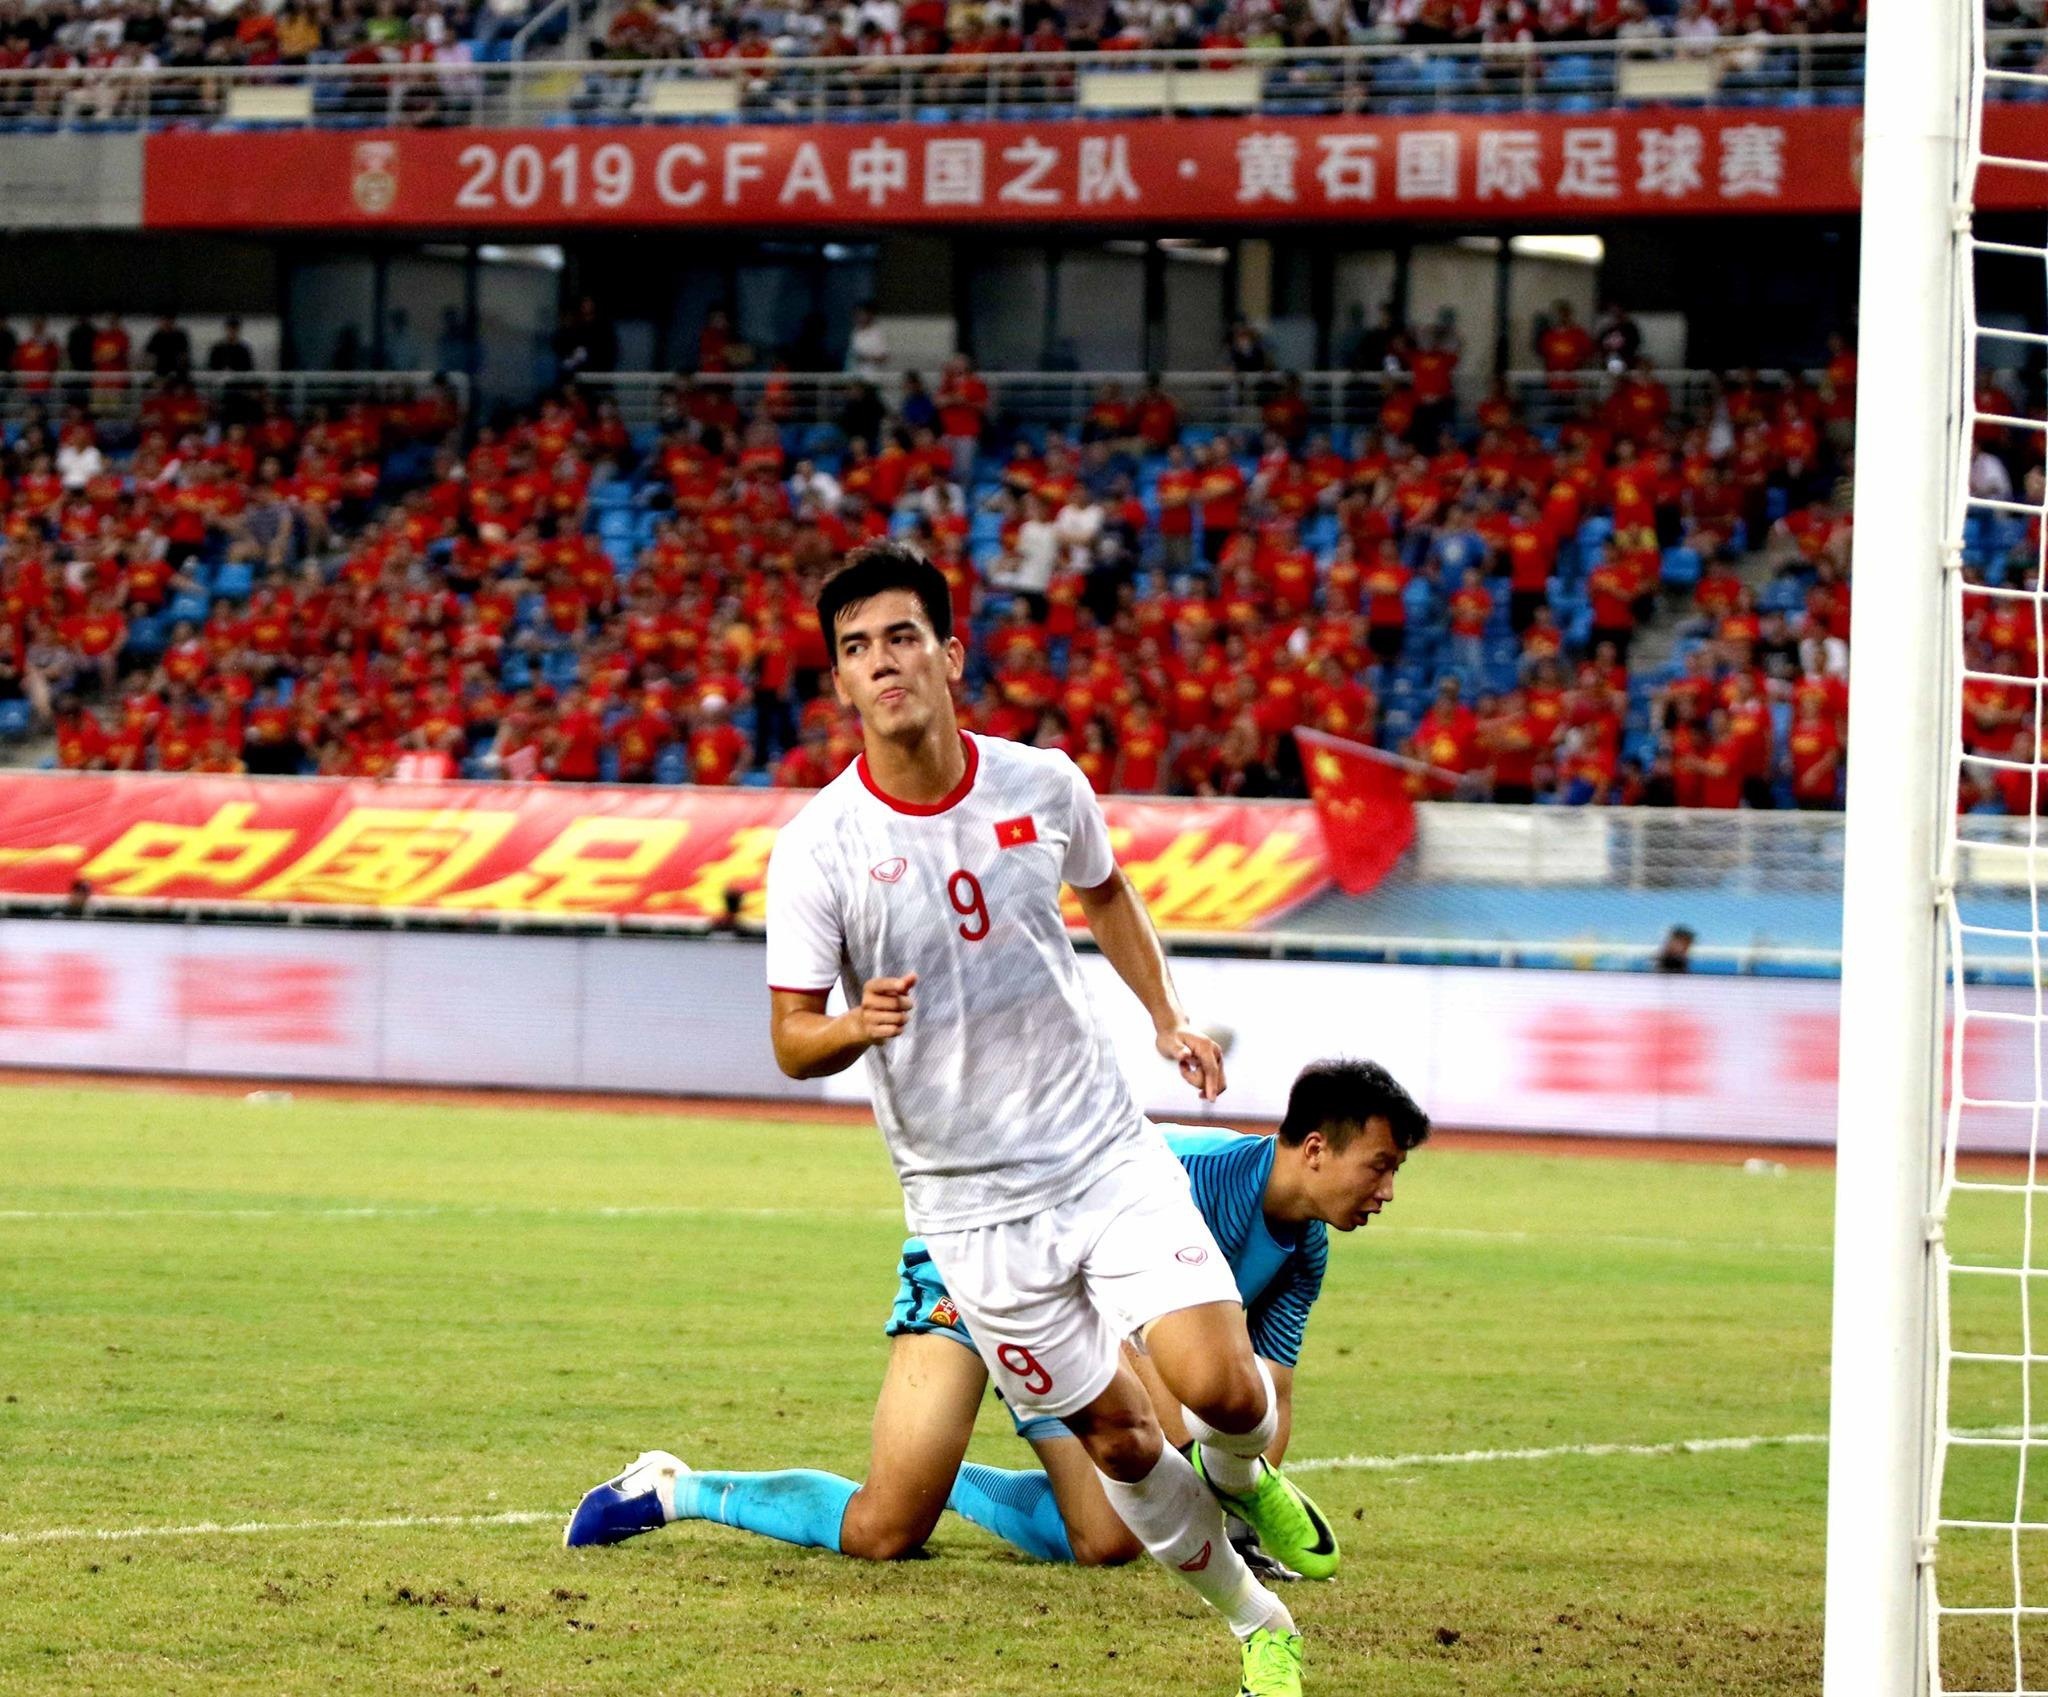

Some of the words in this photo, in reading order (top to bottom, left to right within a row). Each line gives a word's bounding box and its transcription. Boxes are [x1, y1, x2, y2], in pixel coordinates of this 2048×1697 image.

[455, 143, 635, 208] 2019
[947, 869, 990, 941] 9
[997, 1343, 1053, 1395] 9
